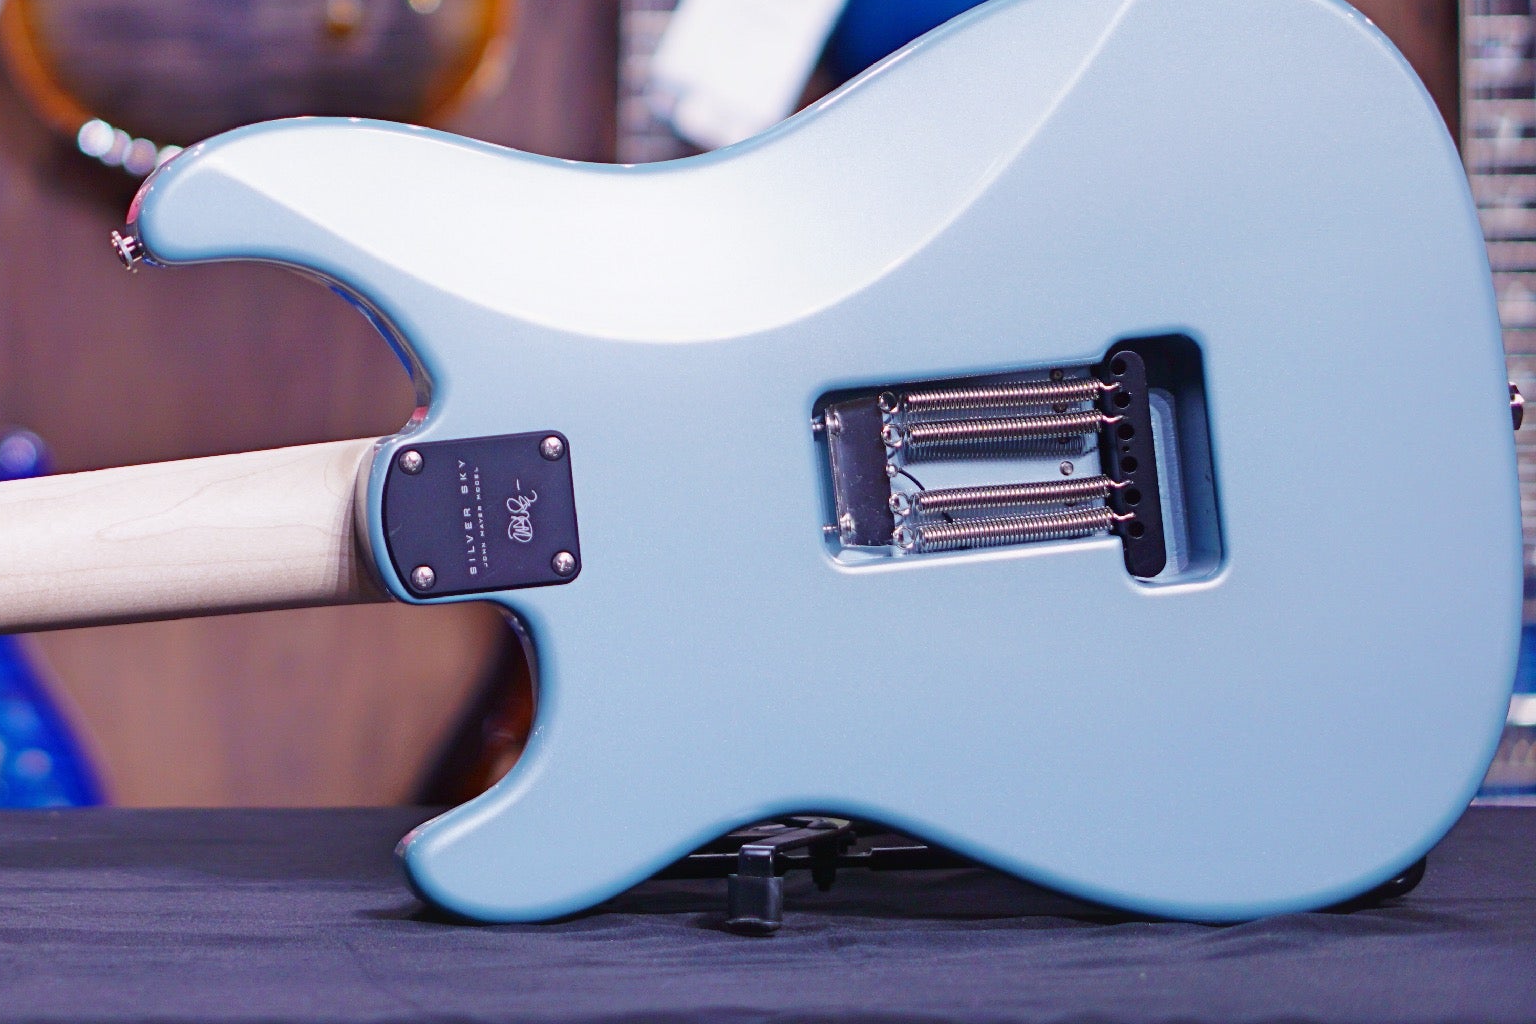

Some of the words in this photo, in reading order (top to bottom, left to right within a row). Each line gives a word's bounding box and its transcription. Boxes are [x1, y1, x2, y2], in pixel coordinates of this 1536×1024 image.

[458, 459, 468, 494] SKY
[477, 505, 485, 537] MAYER
[463, 508, 477, 575] SILVER
